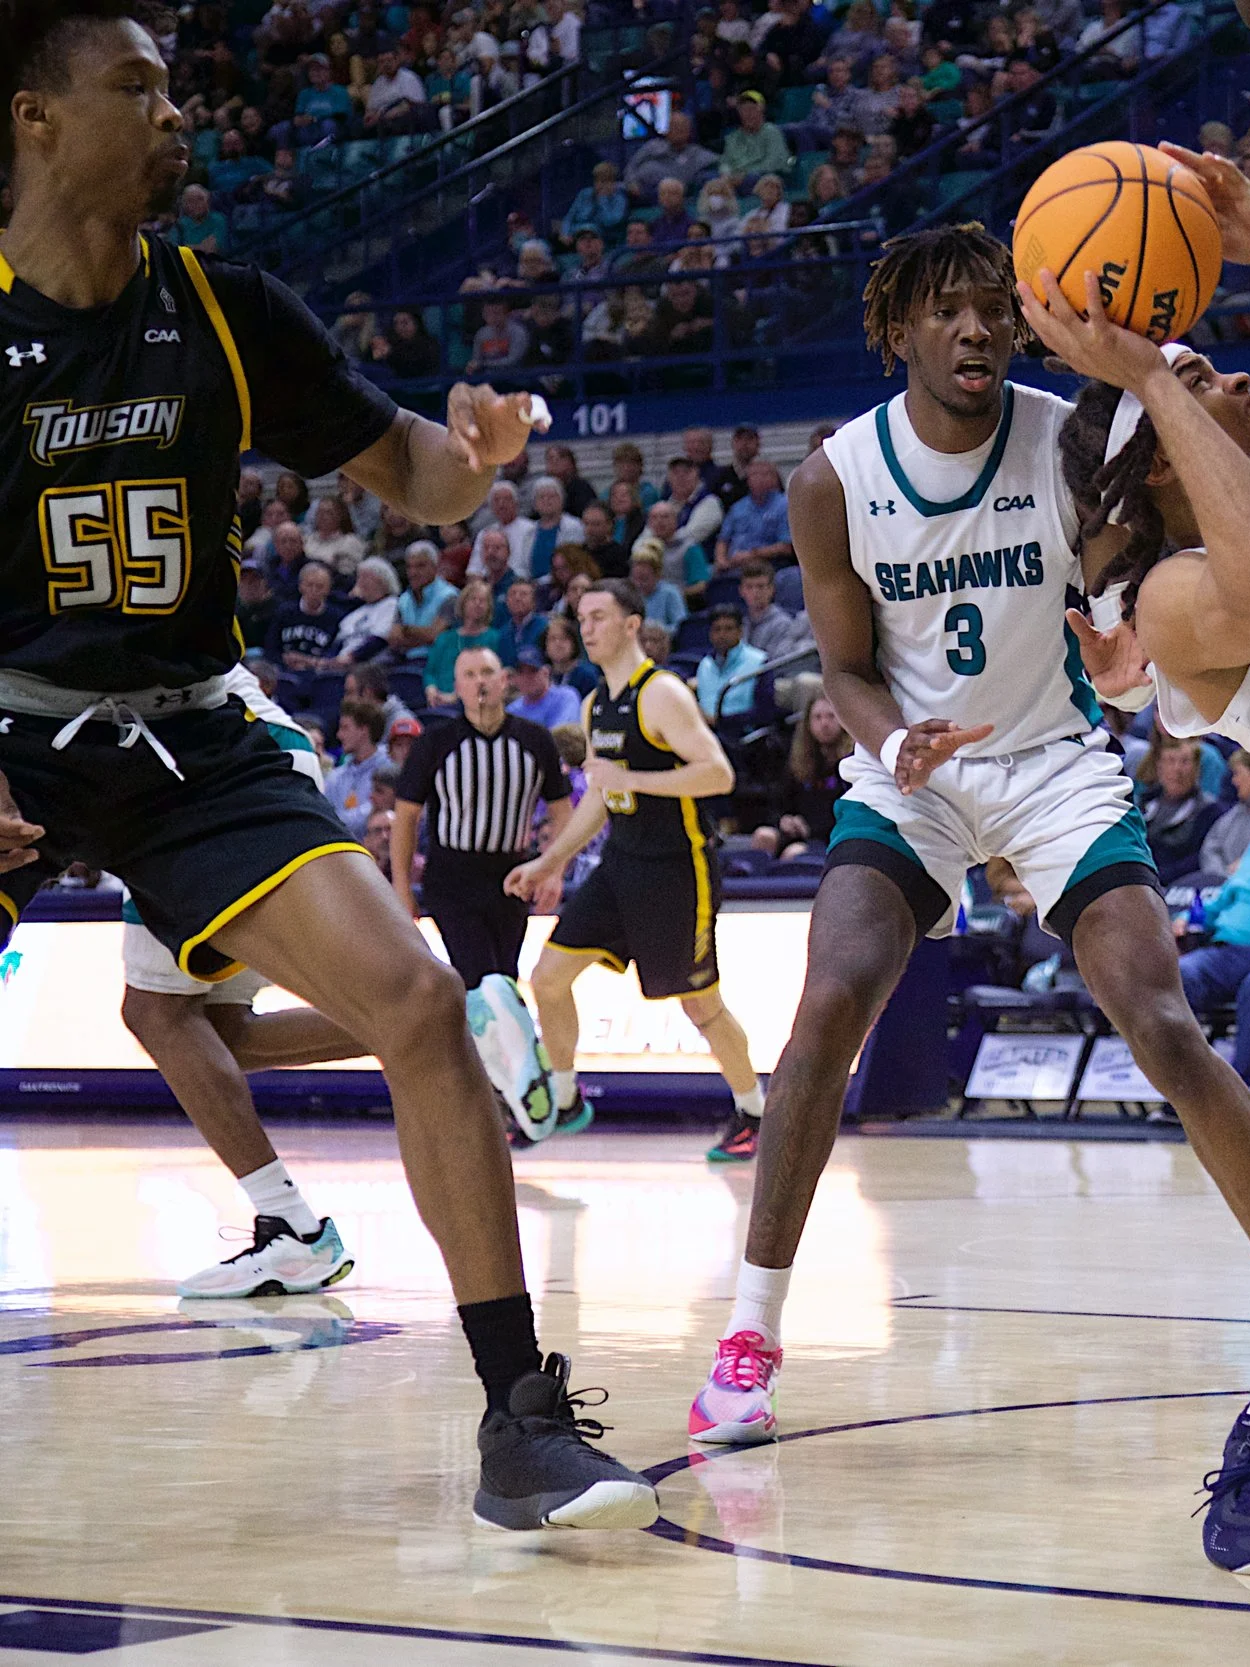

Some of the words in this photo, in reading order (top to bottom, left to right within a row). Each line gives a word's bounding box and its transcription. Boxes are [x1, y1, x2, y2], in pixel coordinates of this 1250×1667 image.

[144, 329, 181, 343] CAA
[25, 397, 185, 464] TOWSON
[572, 401, 628, 435] 101
[993, 494, 1036, 512] CAA
[41, 480, 189, 613] 55
[875, 541, 1044, 601] SEAHAWKS
[944, 603, 987, 677] 3
